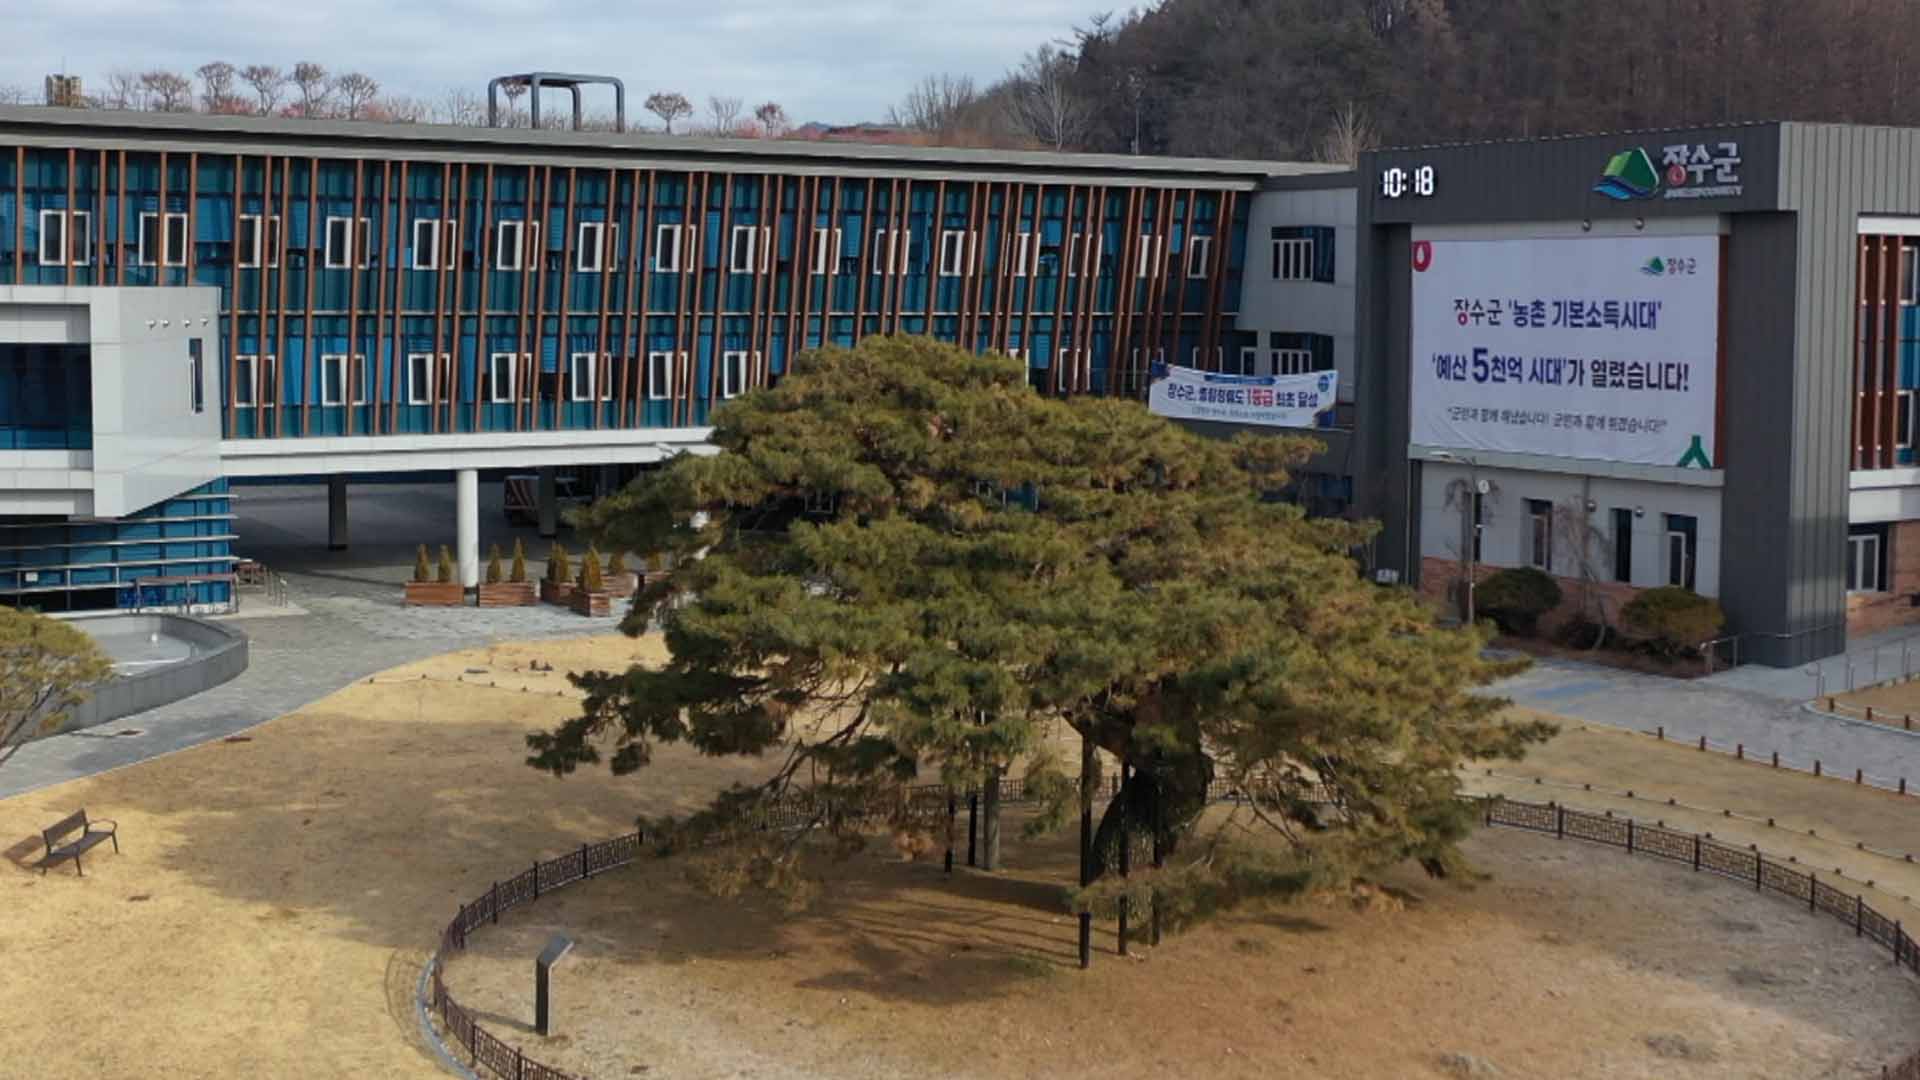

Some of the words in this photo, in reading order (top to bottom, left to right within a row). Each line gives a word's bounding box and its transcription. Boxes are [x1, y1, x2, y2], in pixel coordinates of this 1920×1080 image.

[1663, 142, 1741, 187] 장수군
[1383, 165, 1434, 197] 10:18
[1667, 257, 1697, 275] 장수군
[1454, 299, 1503, 326] 장수군
[1508, 300, 1546, 328] '농촌
[1552, 300, 1662, 330] 기본소득시대'
[1432, 352, 1468, 382] '예산
[1472, 347, 1523, 384] 5천억
[1528, 357, 1585, 387] 시대'가
[1590, 359, 1690, 392] 열렸습니다!
